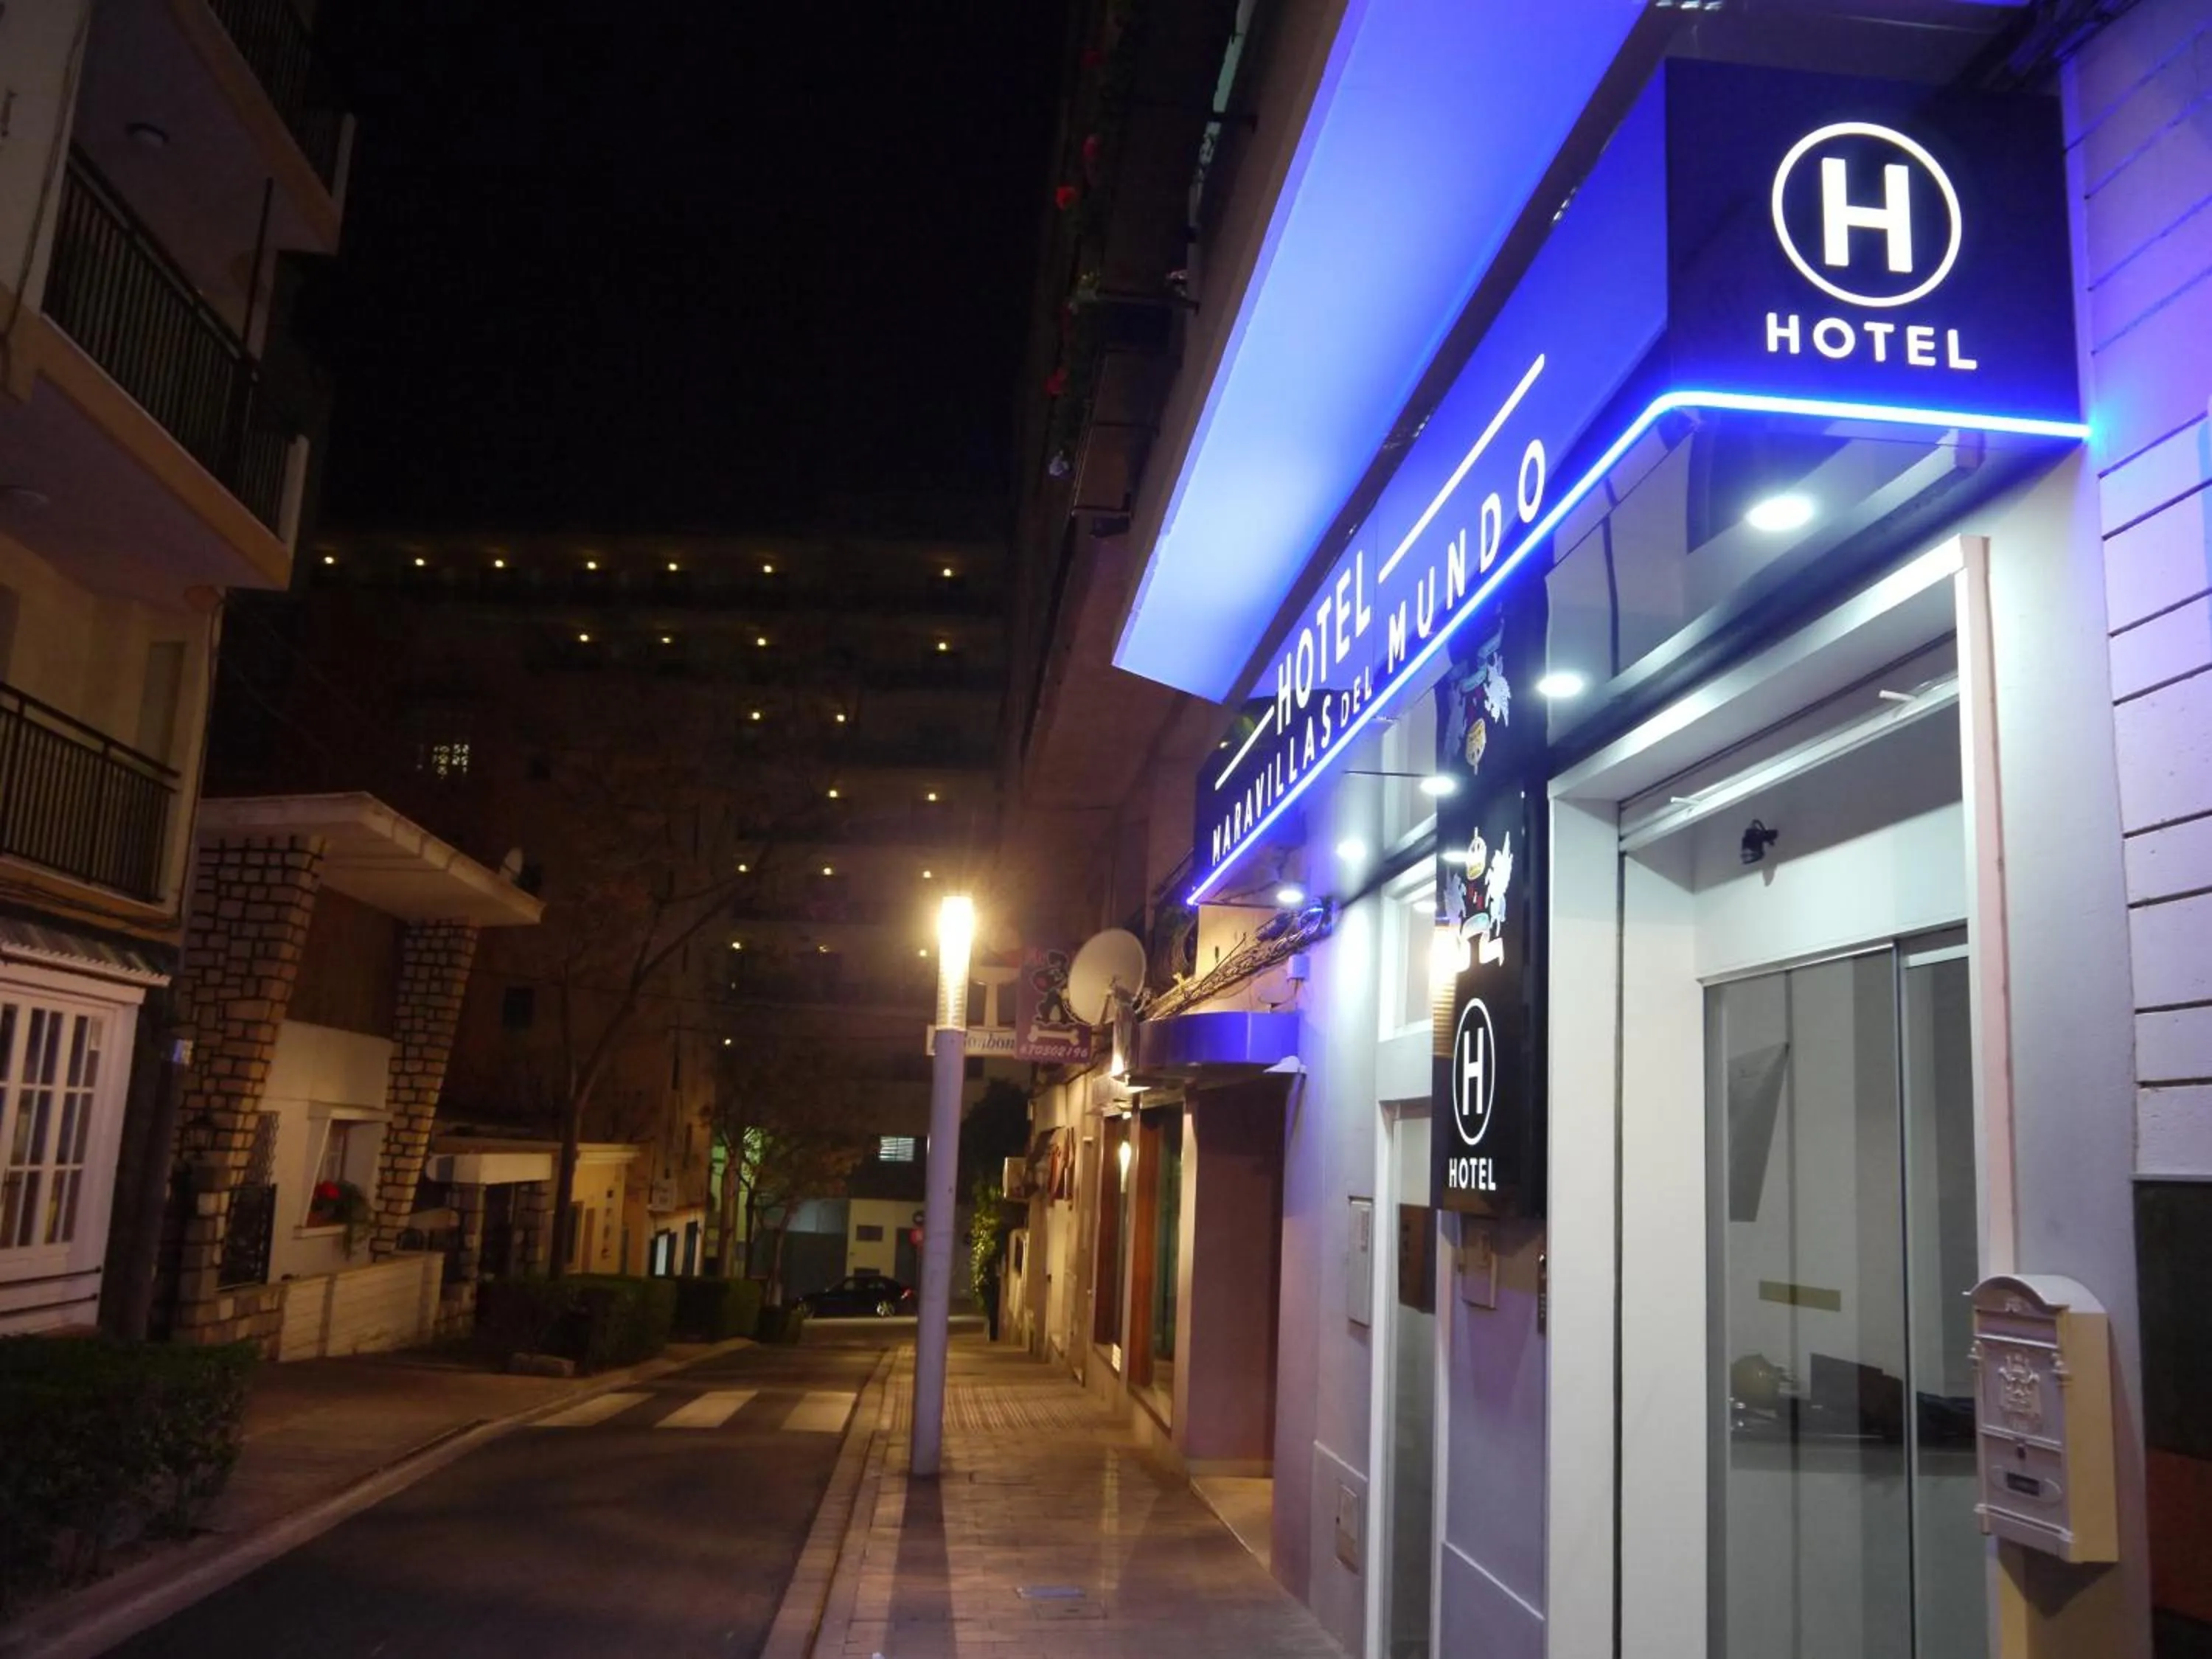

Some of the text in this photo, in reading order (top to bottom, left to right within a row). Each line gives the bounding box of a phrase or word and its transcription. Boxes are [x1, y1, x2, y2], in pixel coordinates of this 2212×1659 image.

[1821, 157, 1913, 273] H
[1767, 312, 1977, 370] HOTEL
[1212, 439, 1546, 866] MARAVILLAS DEL MUNDO
[1277, 551, 1371, 734] HOTEL
[1462, 1027, 1484, 1116] H
[1449, 1158, 1497, 1191] HOTEL
